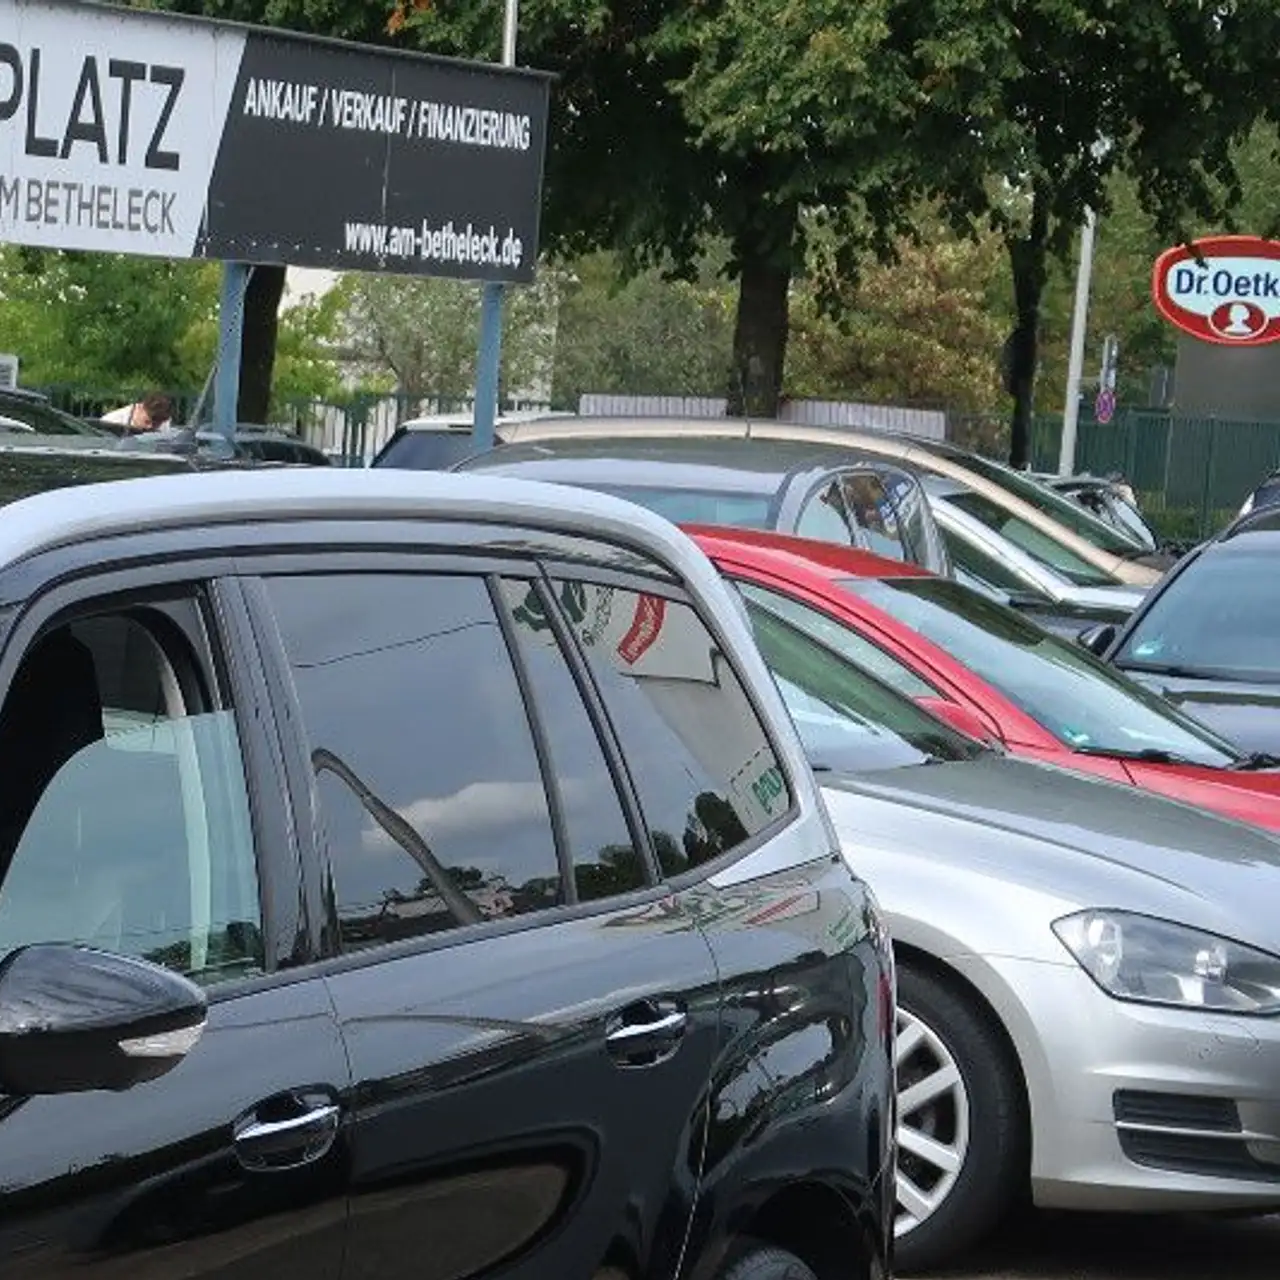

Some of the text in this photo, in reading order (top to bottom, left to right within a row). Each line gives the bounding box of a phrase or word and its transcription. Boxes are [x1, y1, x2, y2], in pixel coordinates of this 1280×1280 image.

[243, 76, 318, 123] ANKAUF
[332, 88, 406, 134] VERKAUF
[419, 100, 531, 151] FINANZIERUNG
[25, 180, 177, 235] BETHELECK
[345, 219, 524, 268] www.am-betheleck.de
